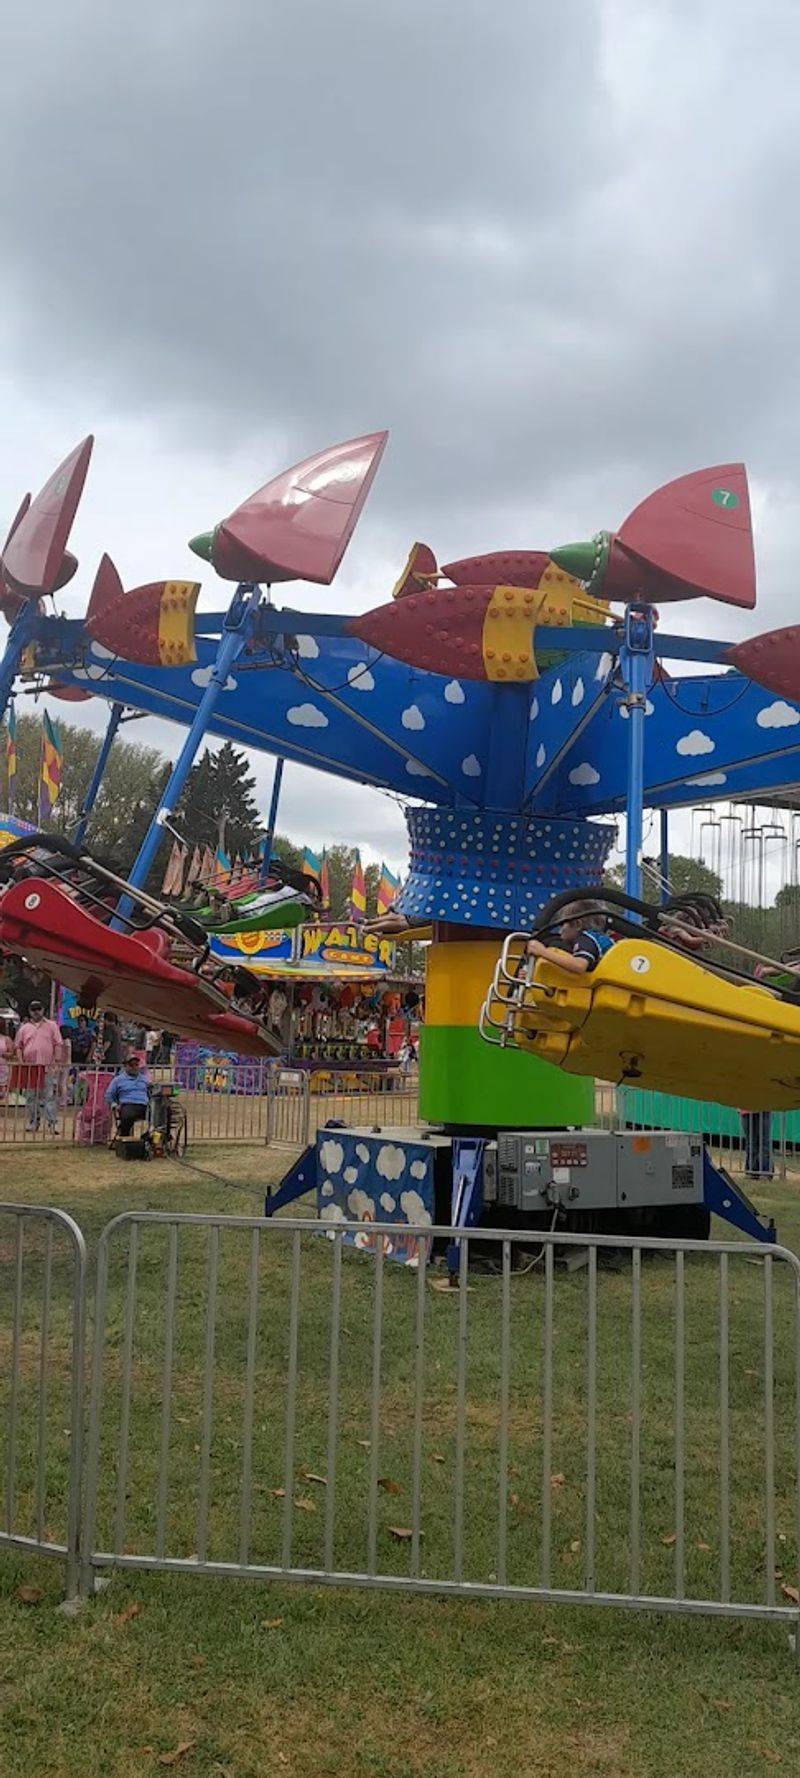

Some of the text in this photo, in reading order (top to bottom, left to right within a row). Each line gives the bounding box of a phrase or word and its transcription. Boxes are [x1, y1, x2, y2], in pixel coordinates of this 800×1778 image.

[720, 490, 730, 505] 7
[303, 927, 391, 968] WATER
[329, 950, 372, 963] GAME
[637, 958, 646, 971] 7
